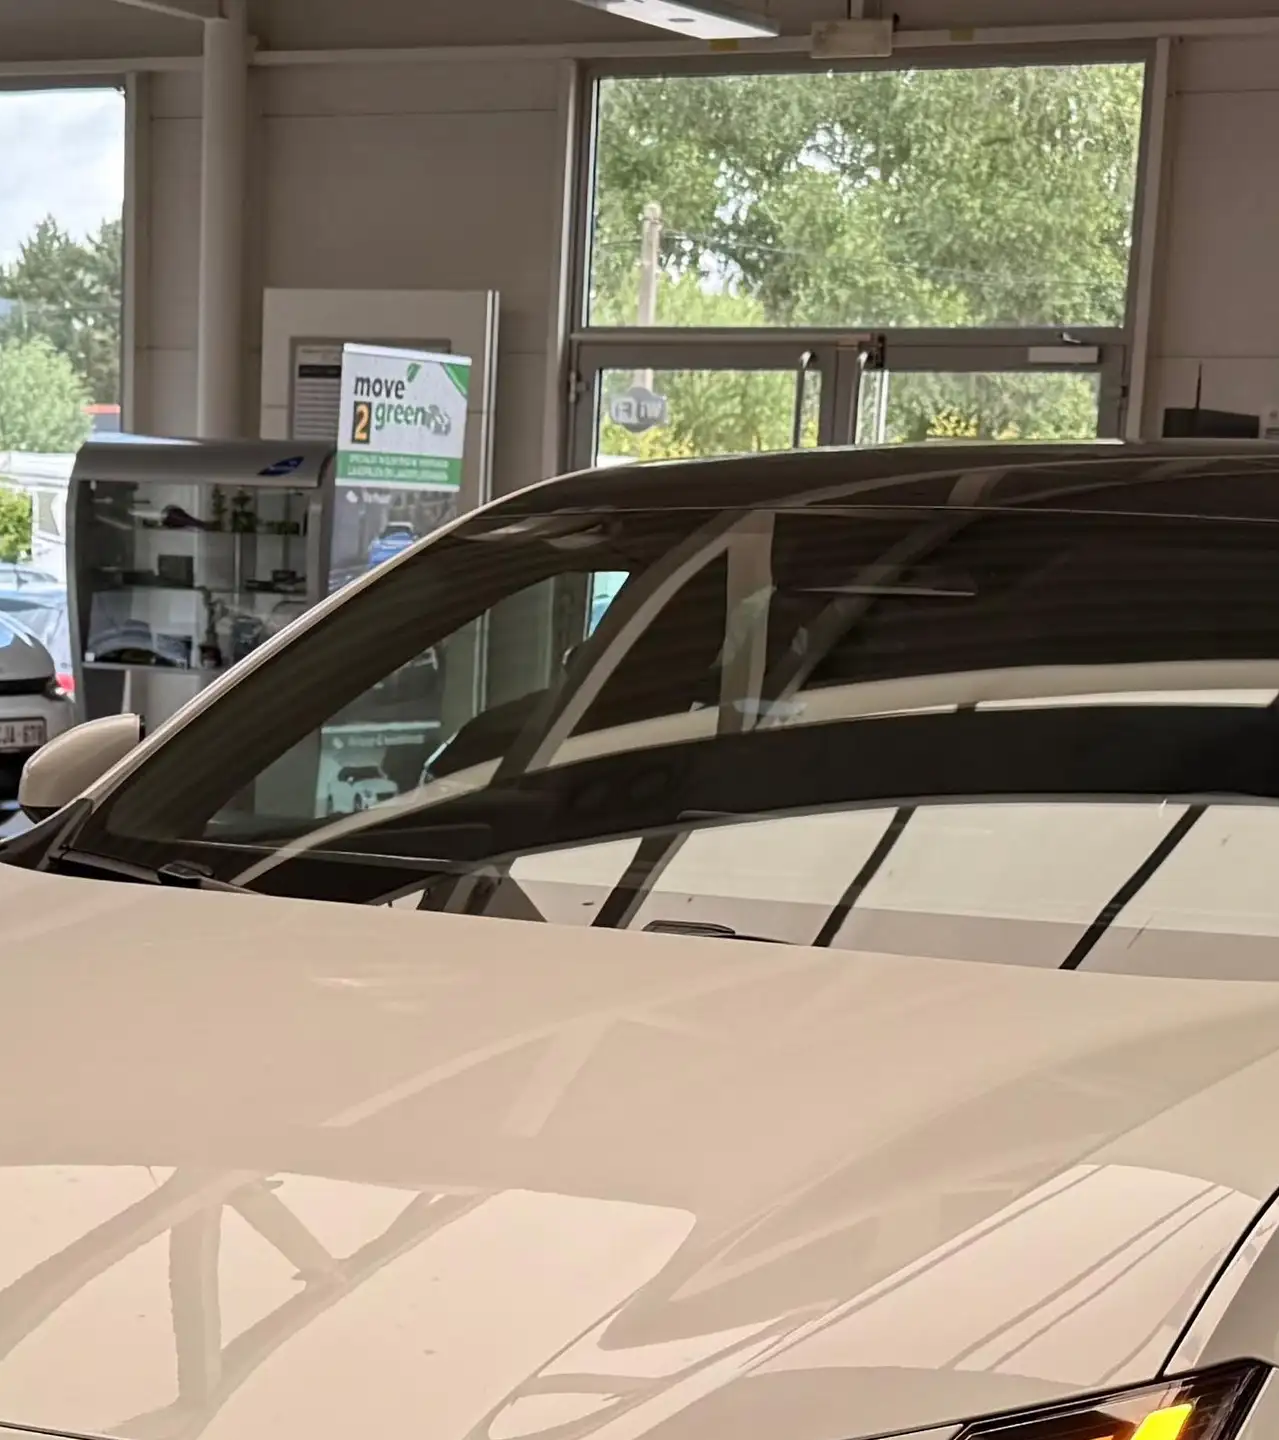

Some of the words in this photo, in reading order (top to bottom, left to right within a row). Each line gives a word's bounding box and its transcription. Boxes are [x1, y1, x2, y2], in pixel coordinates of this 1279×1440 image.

[354, 376, 405, 399] move
[354, 403, 369, 440] 2
[375, 402, 426, 431] green
